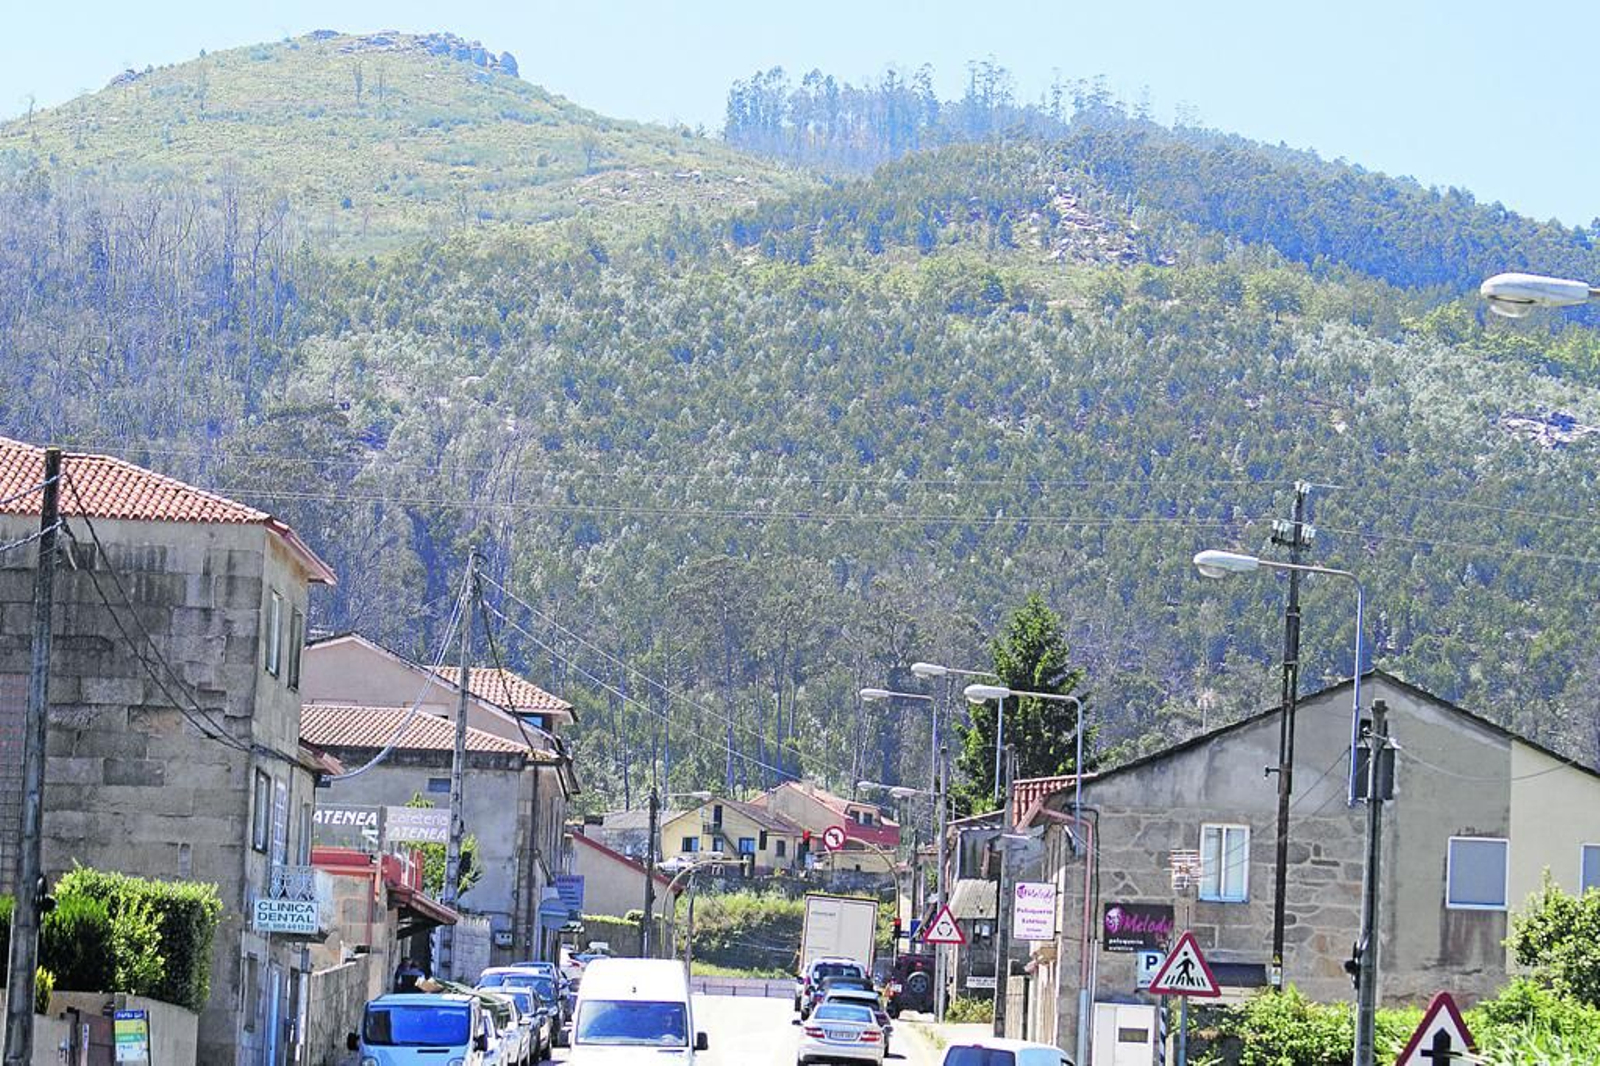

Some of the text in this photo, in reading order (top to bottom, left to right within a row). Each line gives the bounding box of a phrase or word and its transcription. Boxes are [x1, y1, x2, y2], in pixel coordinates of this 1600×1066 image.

[313, 810, 378, 826] ATENEA
[389, 826, 448, 840] ATENEA
[258, 901, 315, 914] CLINICA
[257, 912, 314, 924] DENTAL
[1123, 913, 1174, 934] Melody
[1145, 954, 1159, 971] P
